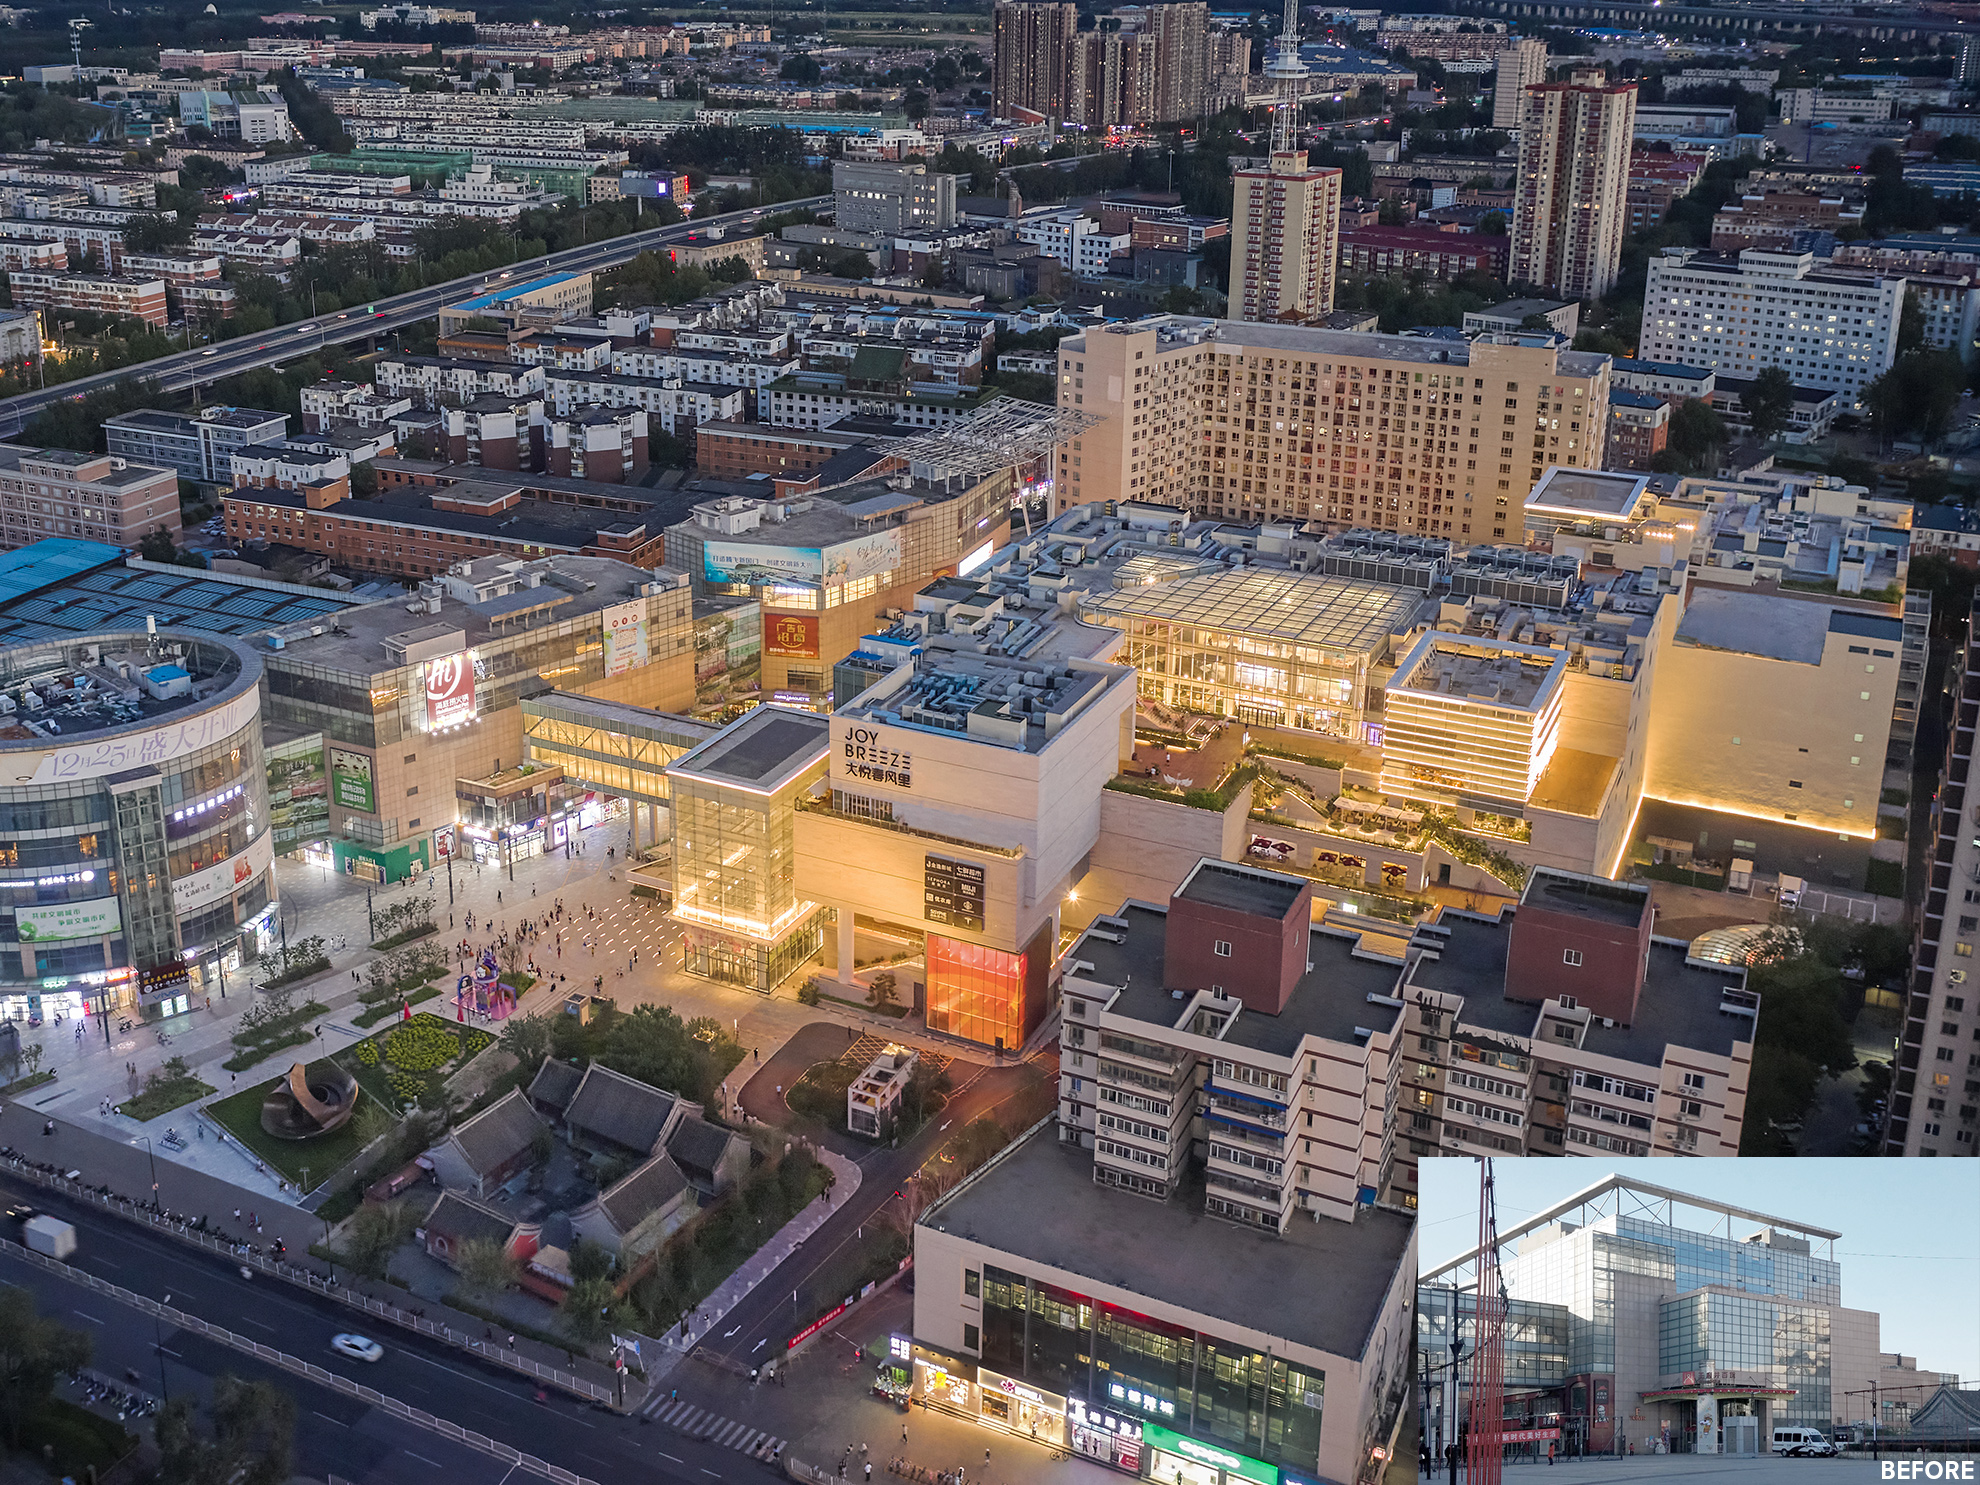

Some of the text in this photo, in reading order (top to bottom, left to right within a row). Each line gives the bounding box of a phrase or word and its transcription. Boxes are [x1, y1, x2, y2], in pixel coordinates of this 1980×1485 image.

[776, 623, 806, 634] 广告位
[845, 727, 879, 745] JOY
[845, 743, 911, 770] BREEZE
[845, 762, 912, 788] 大悦春风里
[961, 883, 977, 894] MUJI
